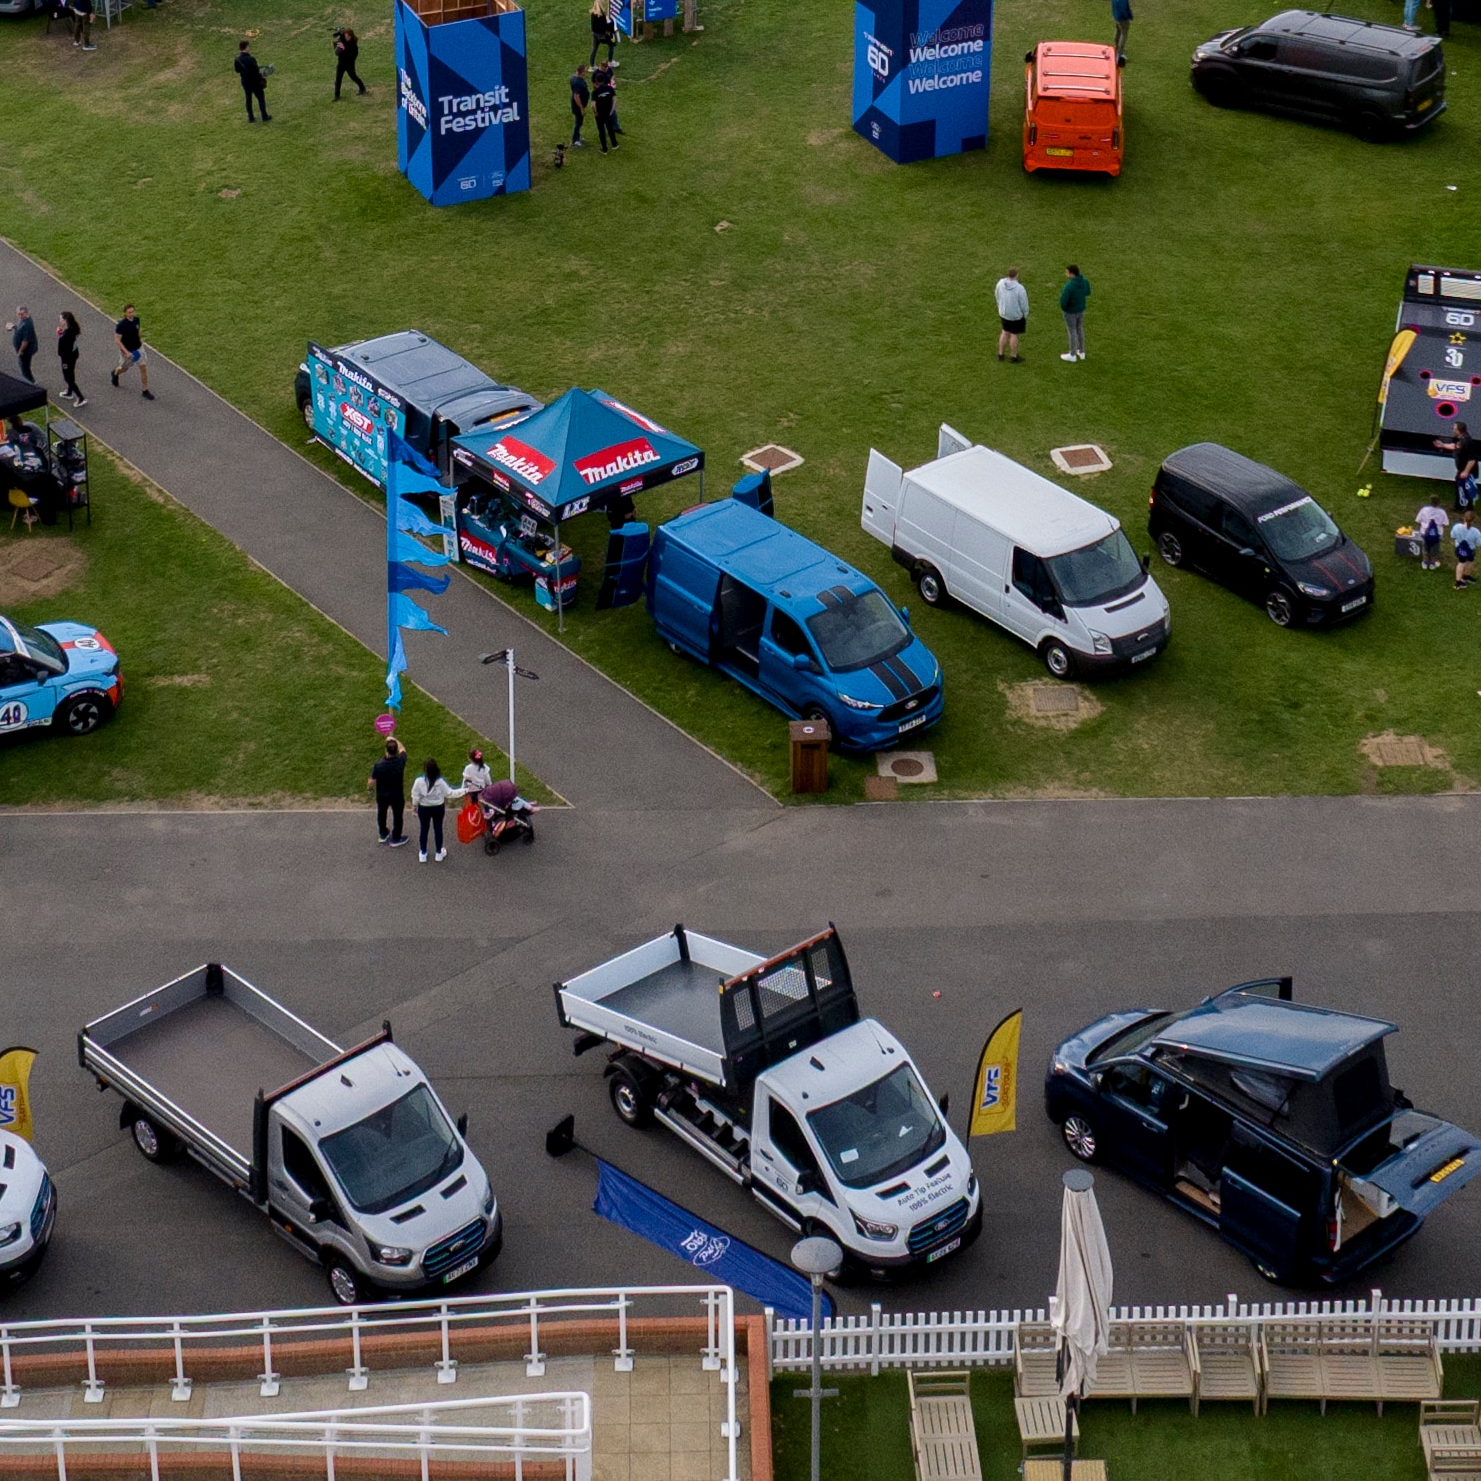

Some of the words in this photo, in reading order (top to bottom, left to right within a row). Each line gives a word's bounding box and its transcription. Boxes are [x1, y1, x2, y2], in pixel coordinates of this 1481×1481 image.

[909, 23, 985, 49] Welcome
[867, 45, 889, 77] 60
[909, 39, 984, 64] Welcome
[909, 54, 983, 79] Welcome
[908, 70, 983, 95] Welcome
[437, 85, 509, 116] Transit
[439, 102, 521, 136] Festival
[1445, 313, 1475, 326] 60
[1435, 383, 1467, 395] VFS
[0, 705, 21, 725] 40
[897, 1193, 915, 1207] Auto
[913, 1187, 927, 1197] Tip
[925, 1173, 953, 1189] Feature
[909, 1198, 929, 1213] 100%
[927, 1185, 954, 1202] Electric
